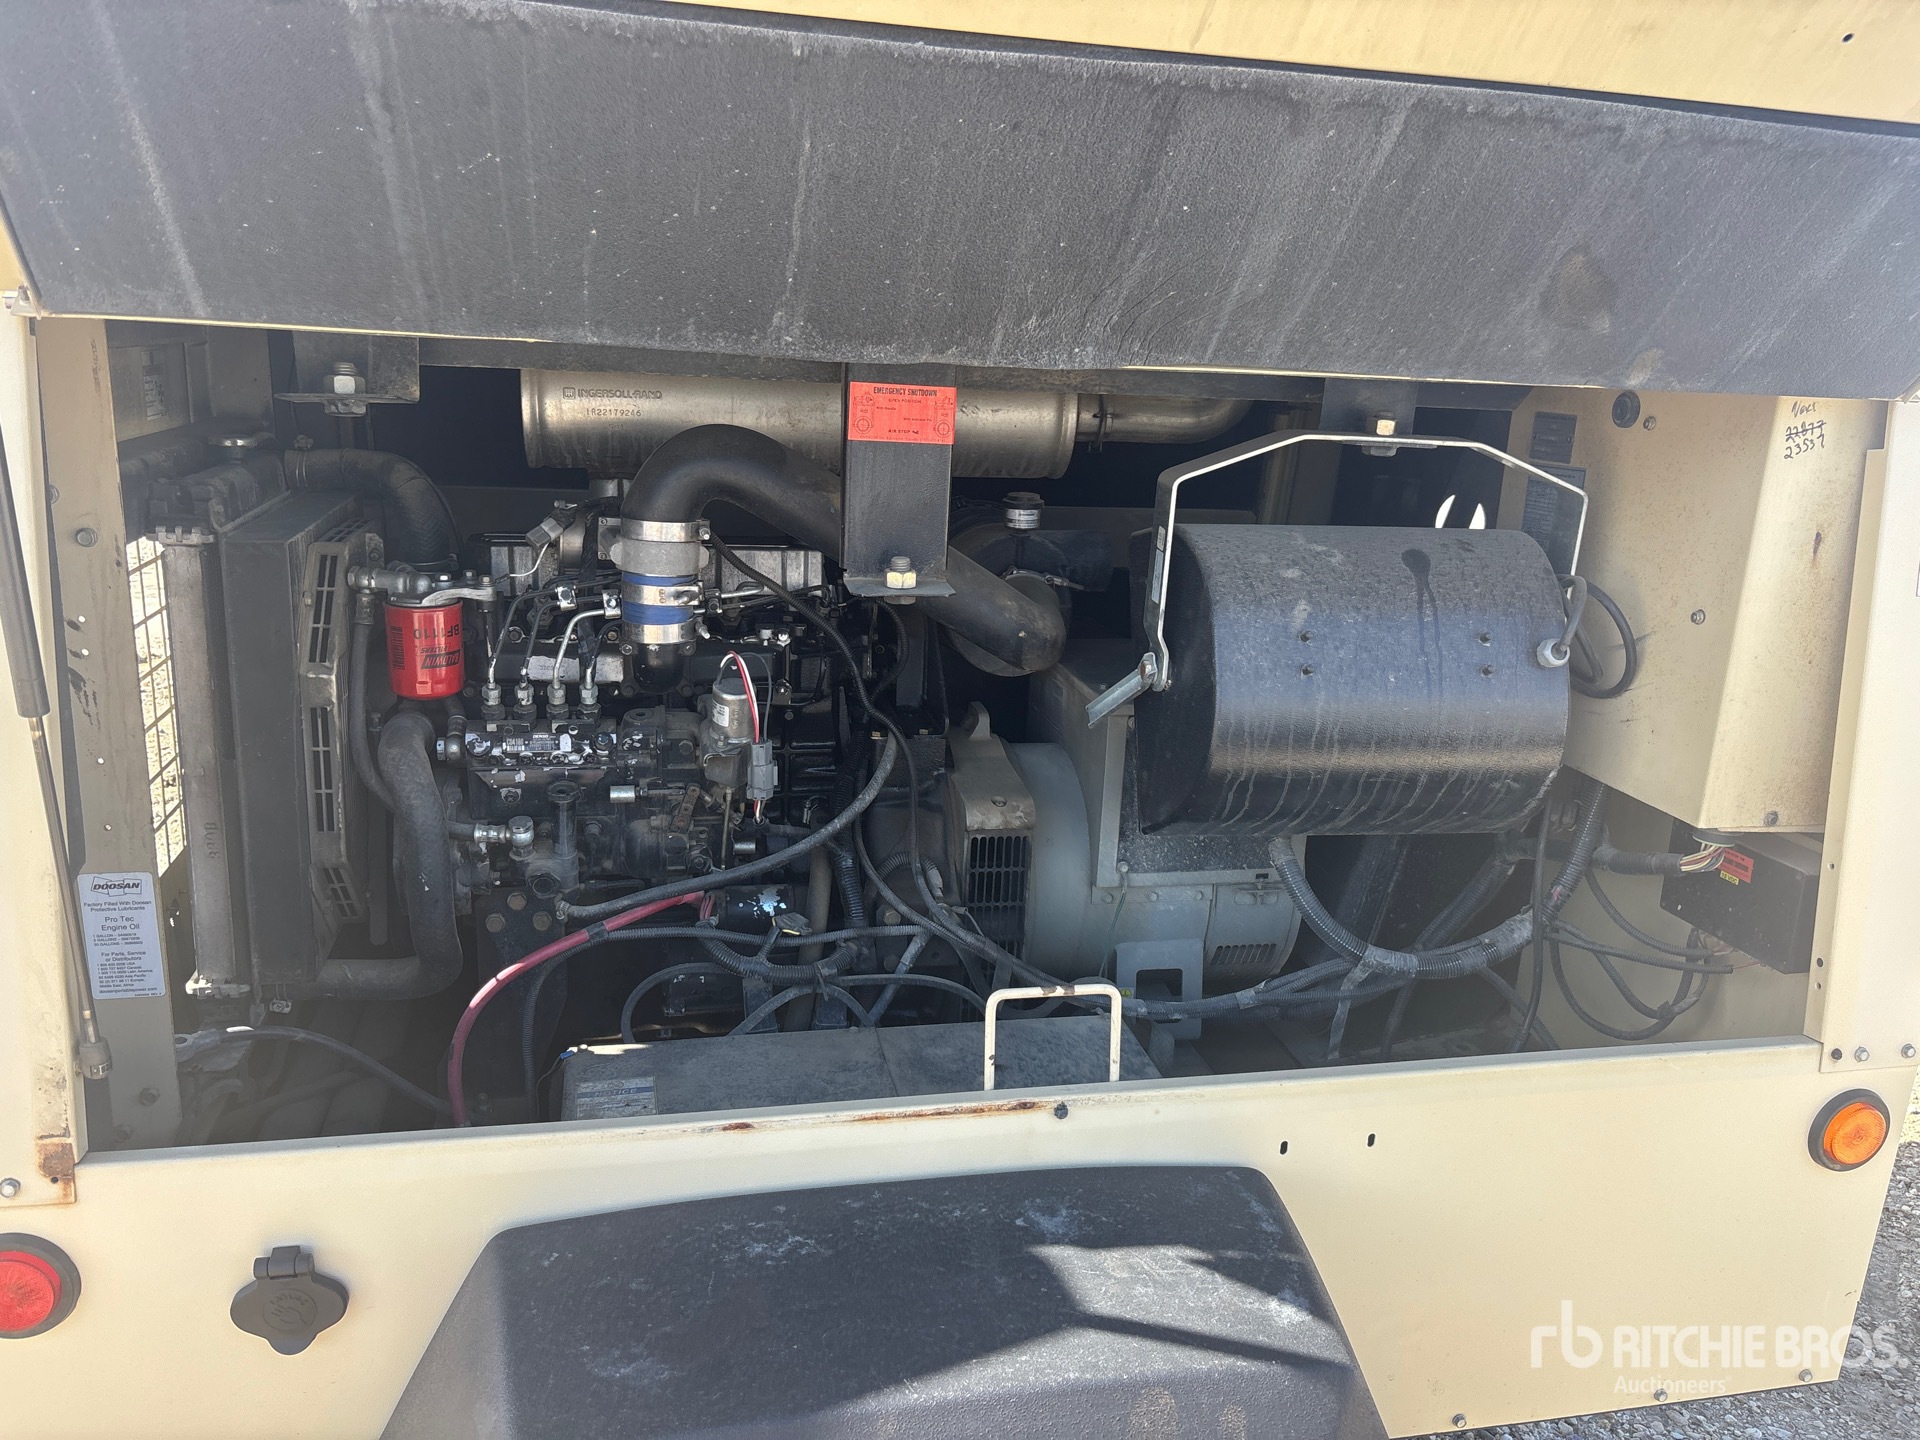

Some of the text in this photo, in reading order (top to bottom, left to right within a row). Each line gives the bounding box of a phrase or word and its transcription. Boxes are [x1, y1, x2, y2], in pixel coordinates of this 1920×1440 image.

[578, 388, 662, 399] INGERSOLL-RAND
[873, 386, 937, 396] EMERGENCY SHUTDOWN
[414, 624, 459, 639] BF1110
[424, 652, 460, 667] BALDWIN
[93, 882, 140, 890] DOOSAN
